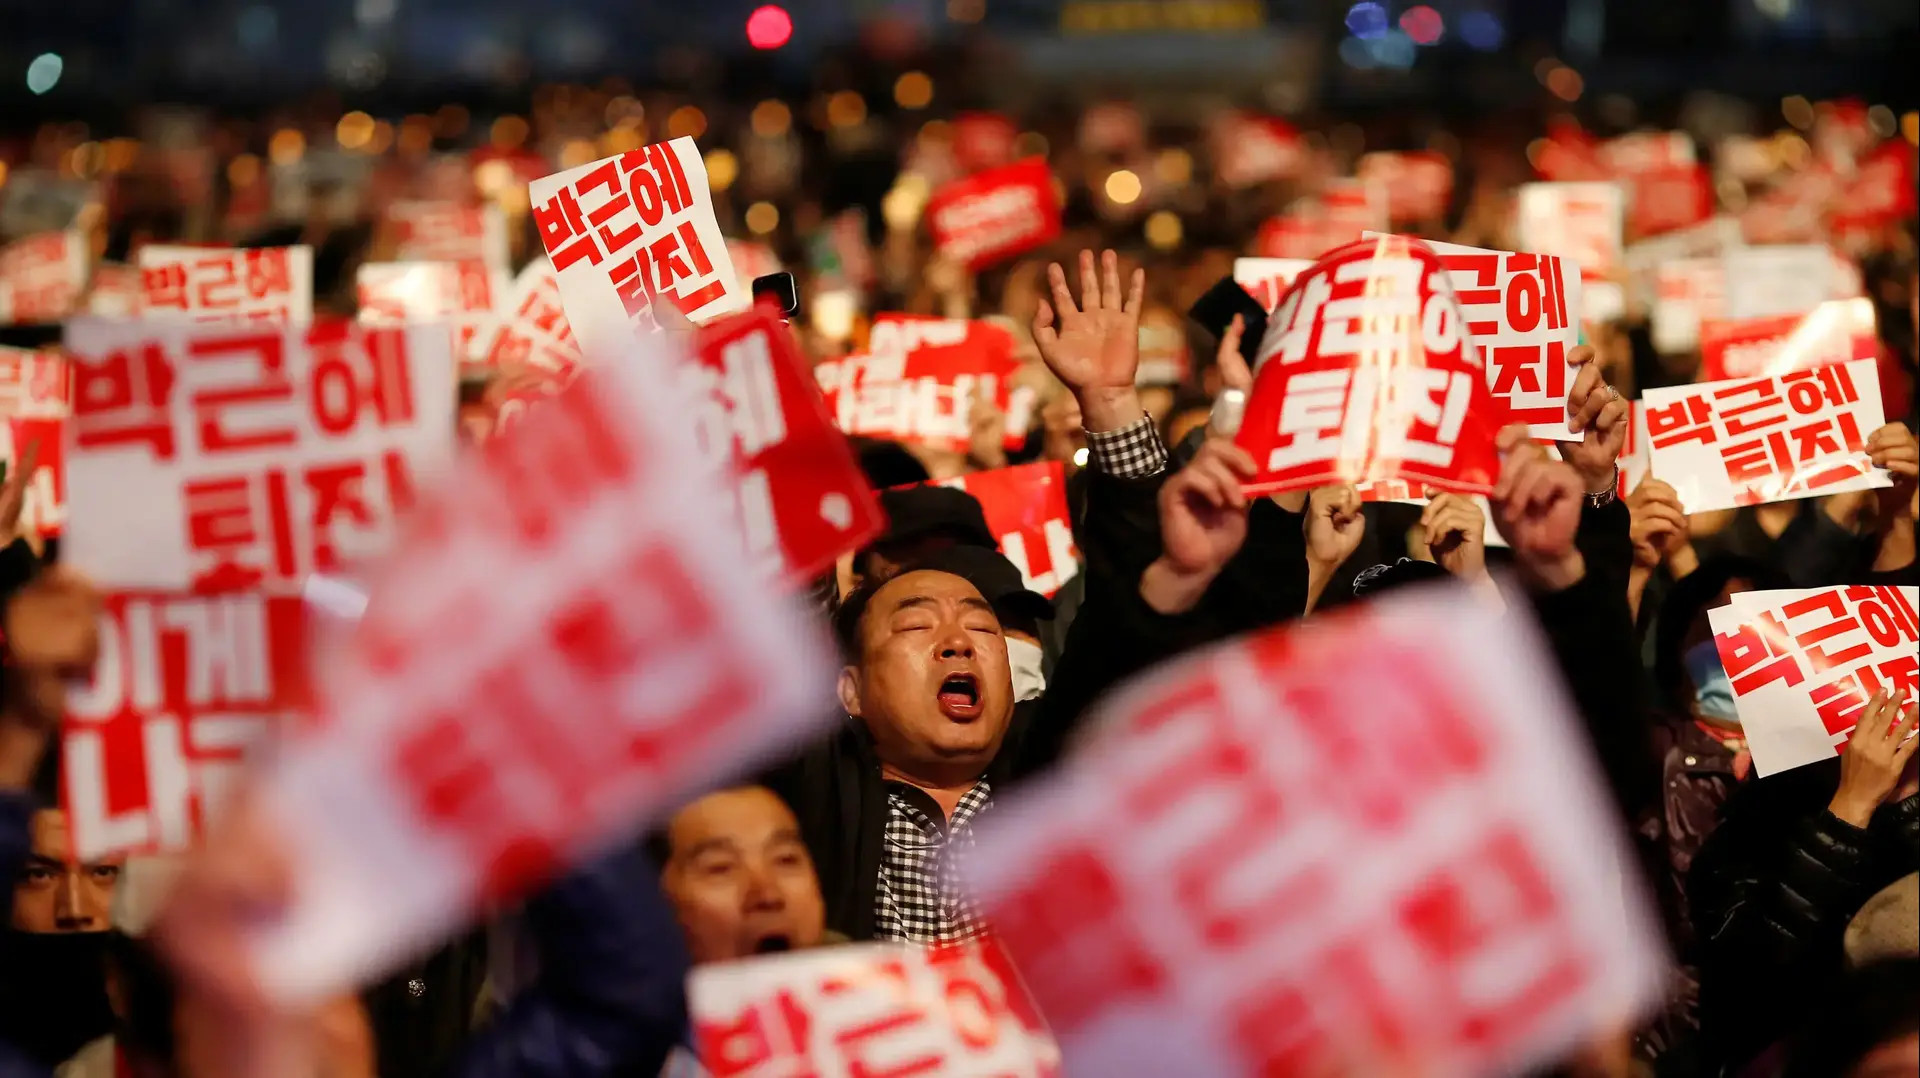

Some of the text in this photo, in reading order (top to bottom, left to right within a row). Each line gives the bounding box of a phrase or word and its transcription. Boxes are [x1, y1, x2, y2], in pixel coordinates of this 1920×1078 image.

[532, 140, 693, 272] 박근혜
[142, 247, 291, 311] 박근혜
[1441, 254, 1568, 336] 근혜
[72, 317, 416, 460] 박근혜
[1267, 367, 1473, 473] 퇴진
[1646, 364, 1859, 450] 박근혜
[1720, 412, 1873, 505] 퇴진
[1714, 585, 1919, 697] 박근혜
